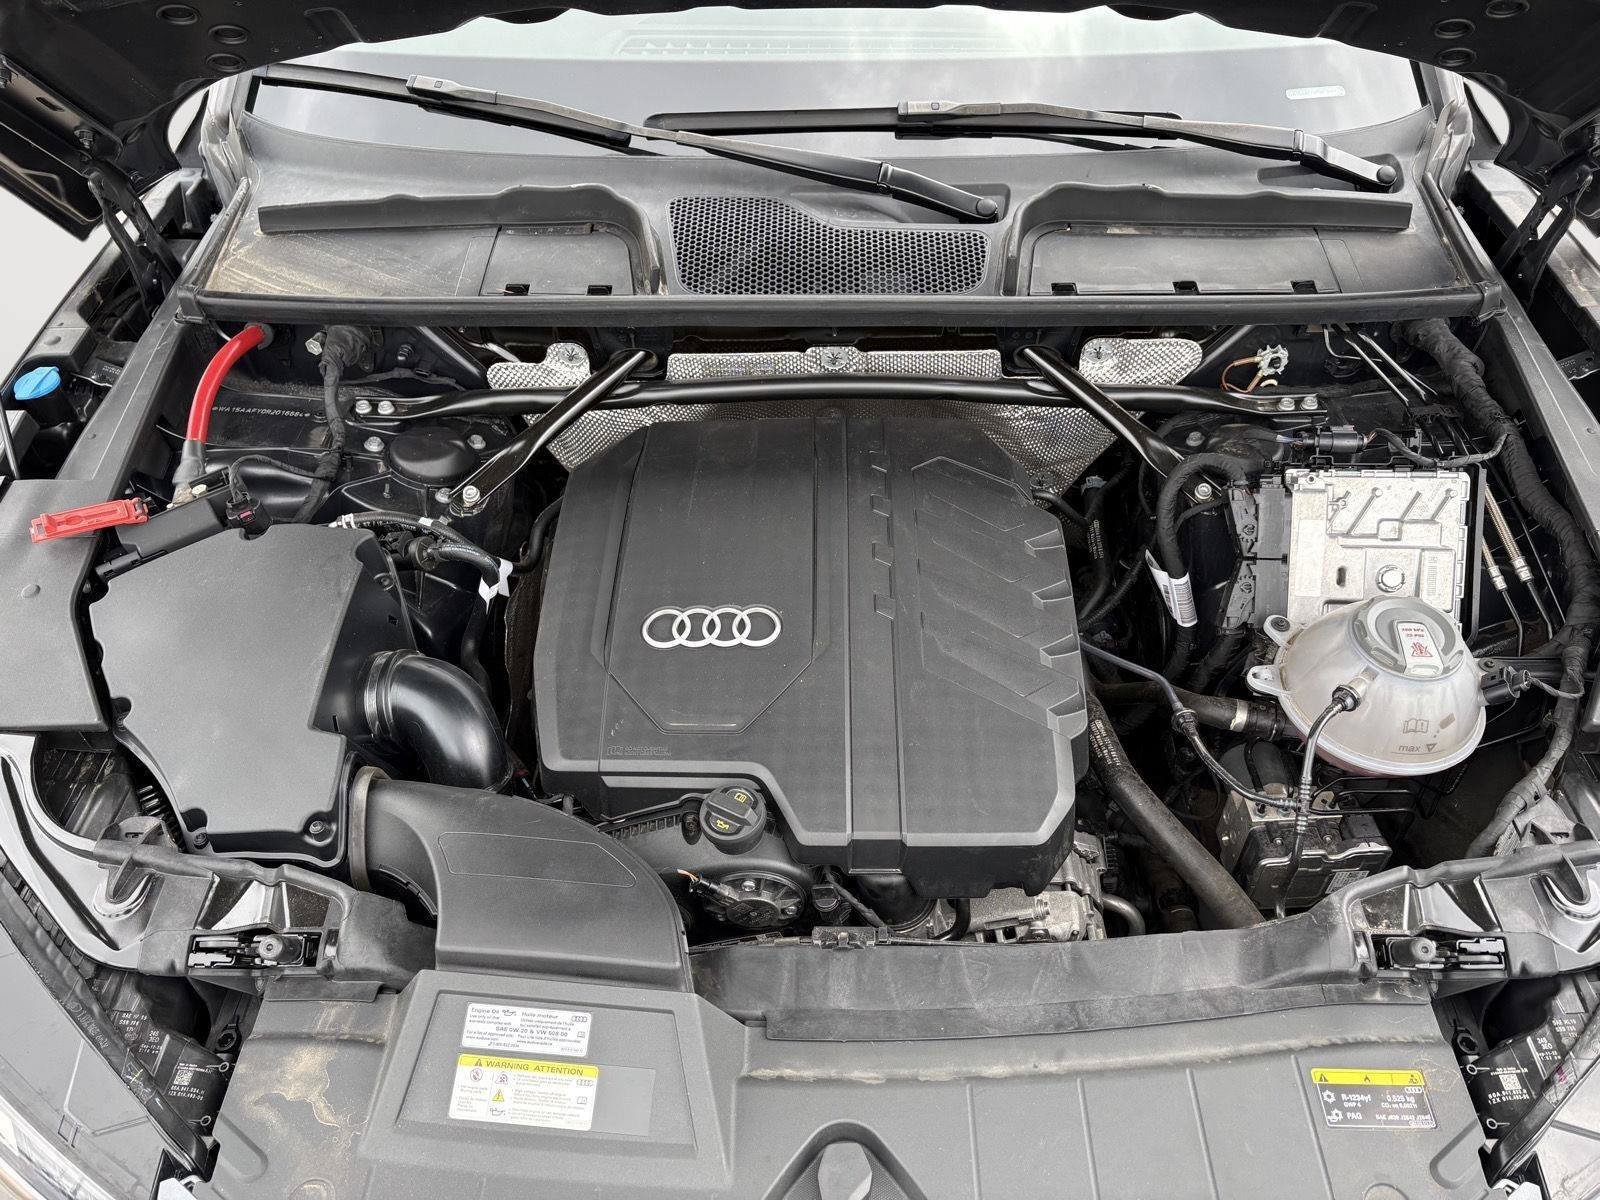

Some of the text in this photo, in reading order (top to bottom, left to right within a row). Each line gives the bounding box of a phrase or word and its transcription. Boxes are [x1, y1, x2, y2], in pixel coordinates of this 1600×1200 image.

[1398, 744, 1421, 753] max
[485, 1060, 584, 1076] WARNING ATTENTION
[1341, 1093, 1371, 1103] R-1234yf
[1346, 1112, 1363, 1120] PAG
